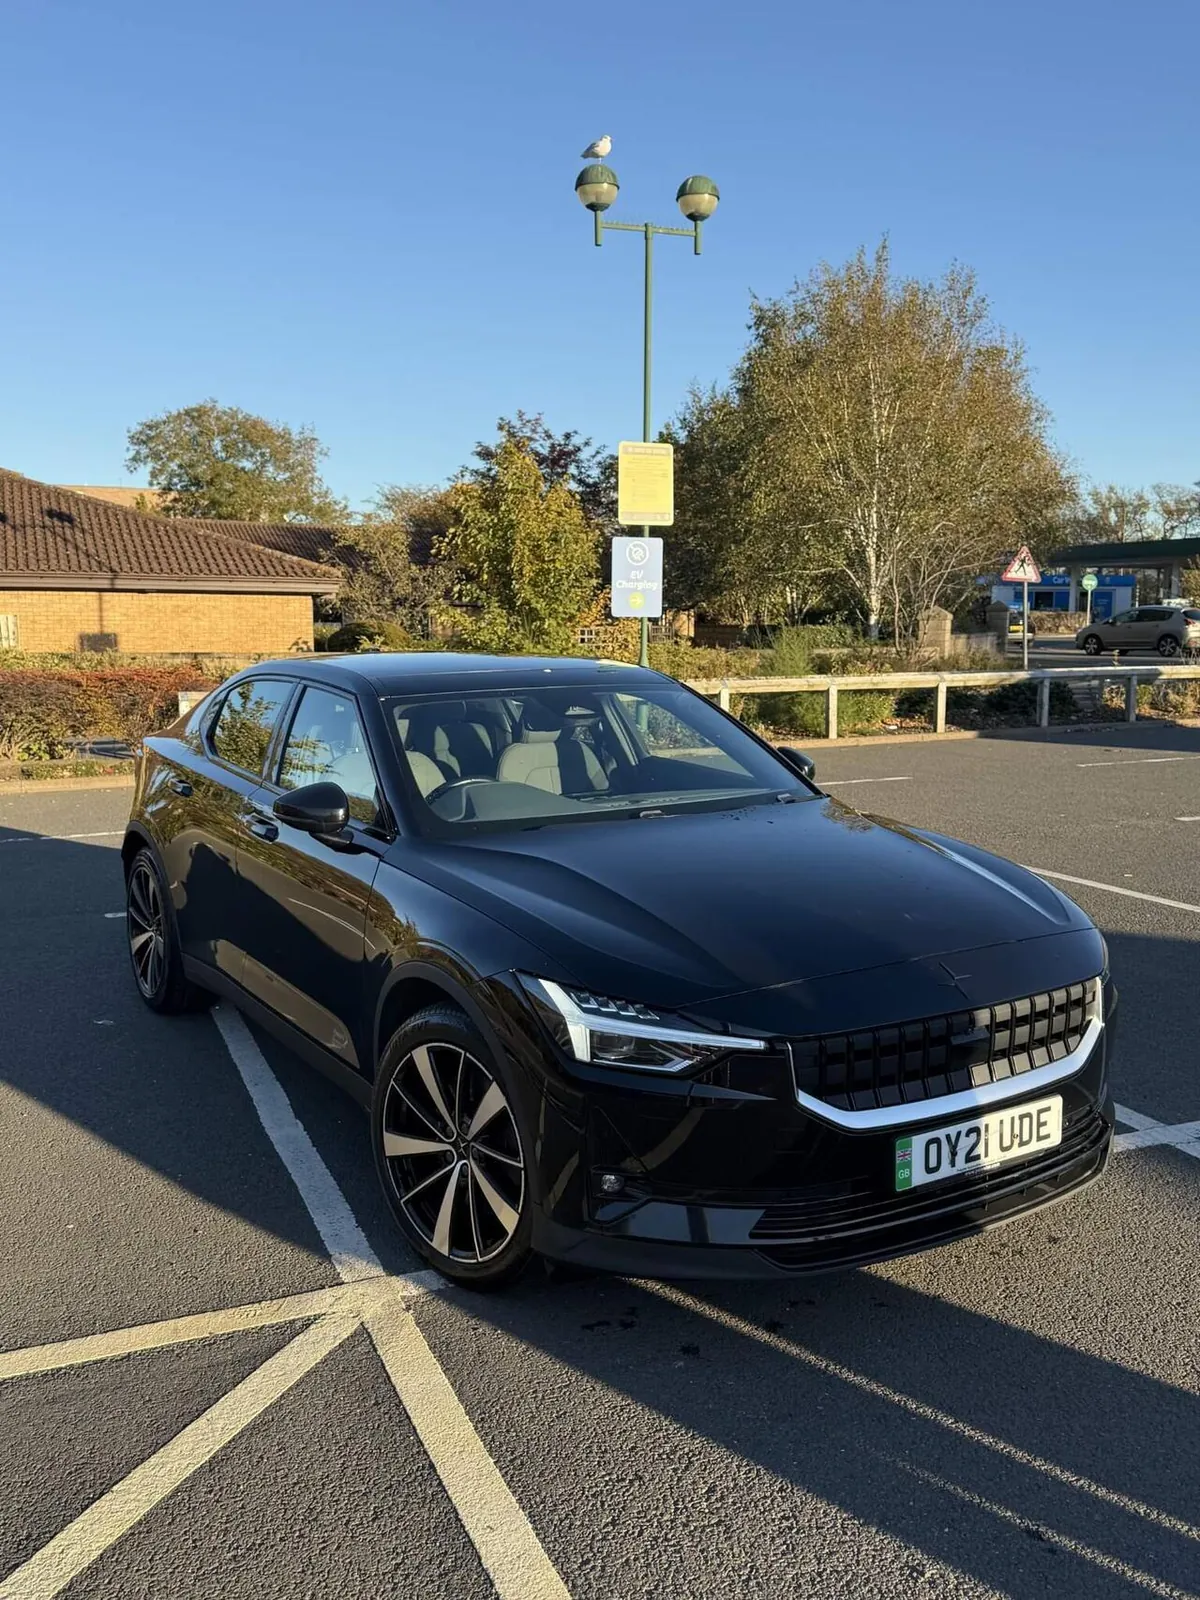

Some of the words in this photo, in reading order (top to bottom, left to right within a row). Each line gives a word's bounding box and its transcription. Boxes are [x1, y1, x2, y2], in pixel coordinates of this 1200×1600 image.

[630, 569, 644, 579] EV
[616, 578, 659, 591] Charging
[924, 1123, 989, 1175] OY21
[999, 1106, 1052, 1153] UDE
[898, 1168, 910, 1180] GB
